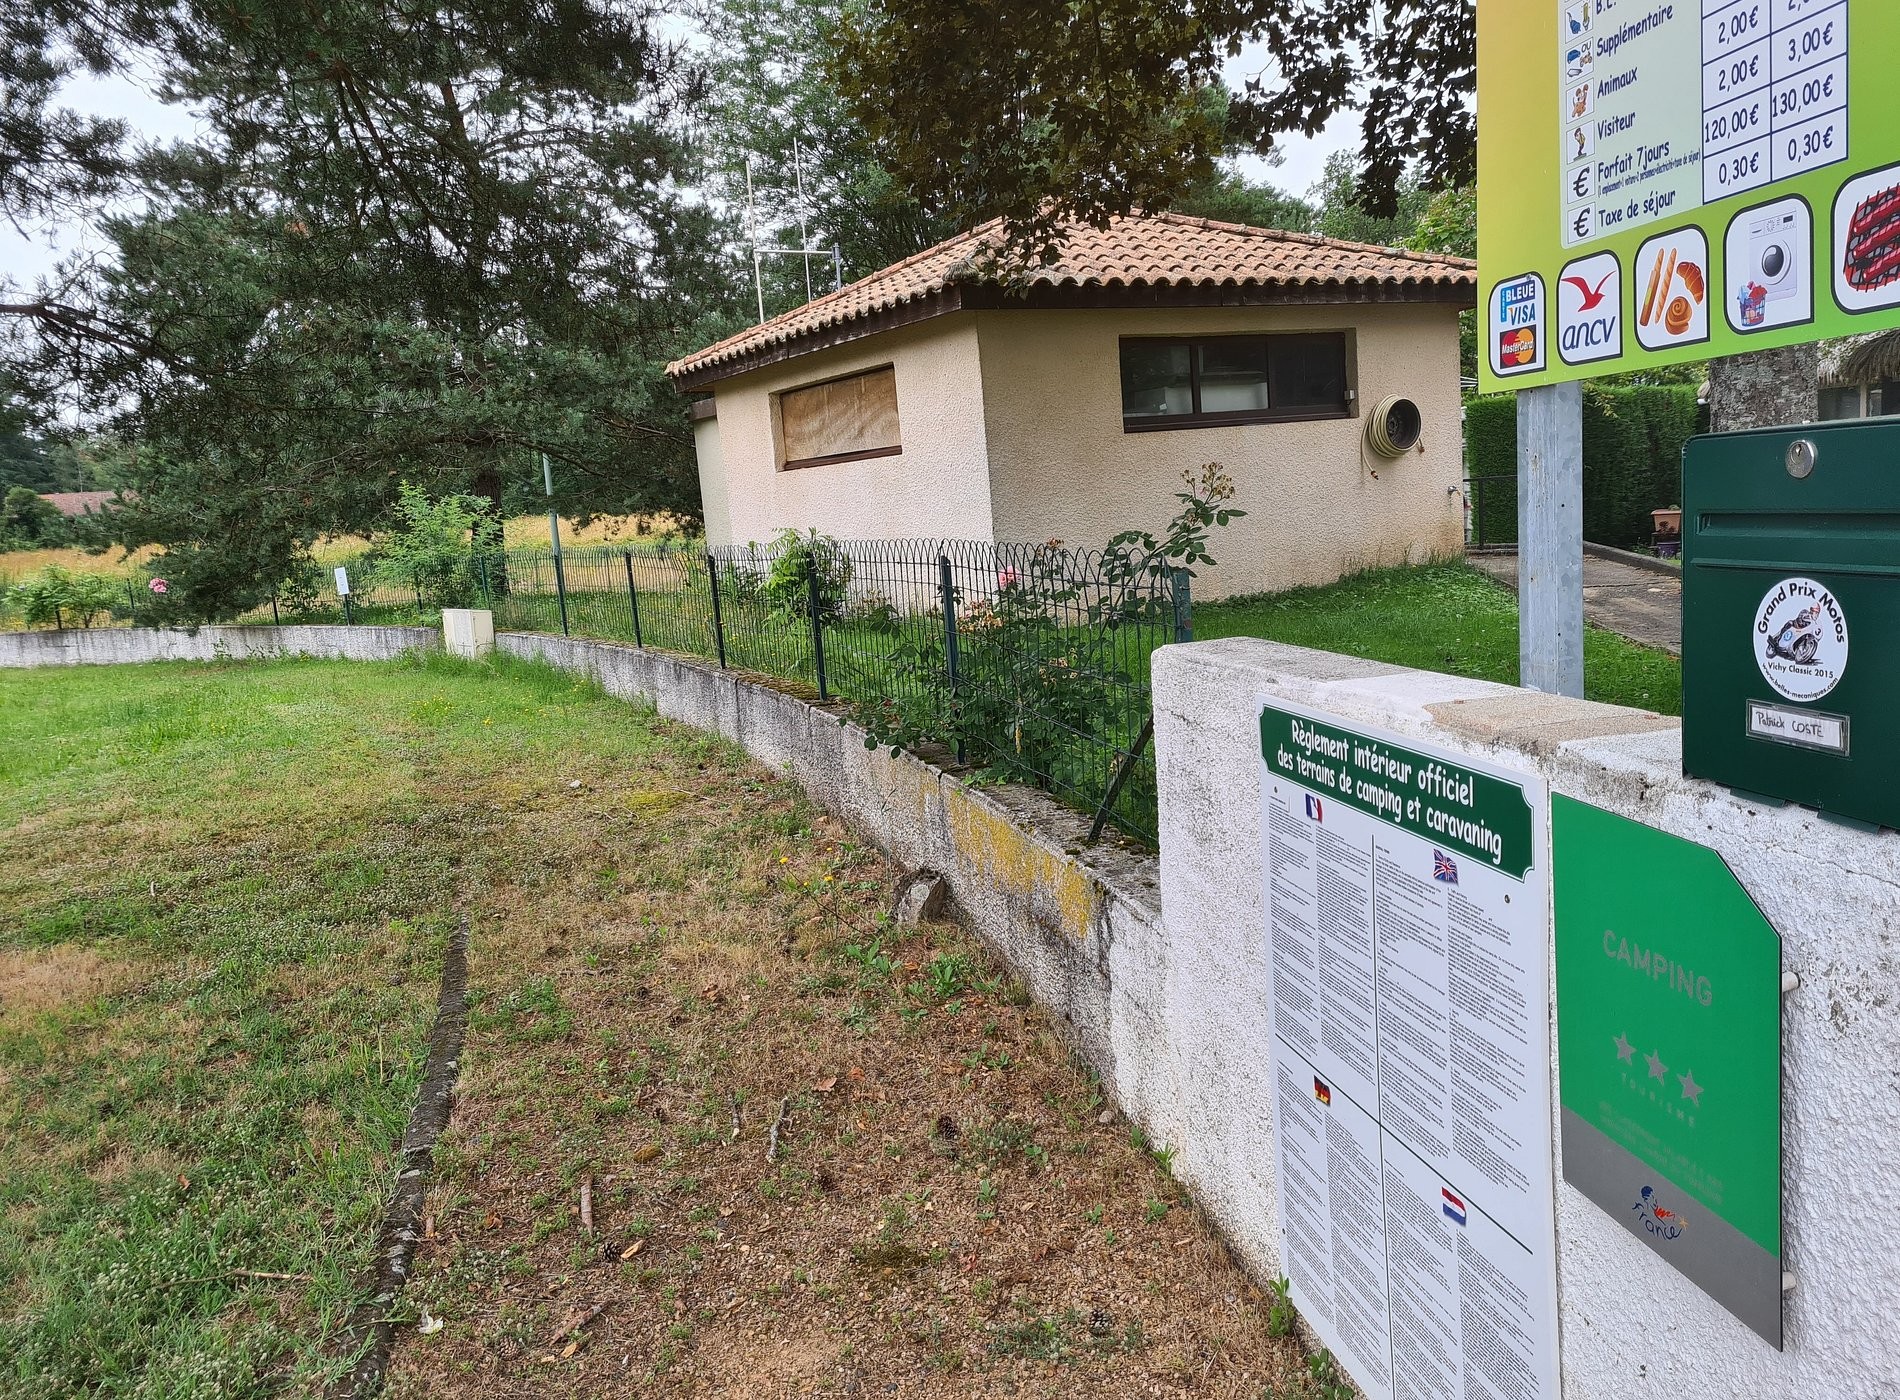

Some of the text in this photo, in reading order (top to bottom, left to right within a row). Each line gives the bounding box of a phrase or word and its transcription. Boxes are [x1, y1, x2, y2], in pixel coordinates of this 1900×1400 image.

[1581, 40, 1592, 52] OU
[1597, 5, 1673, 57] Supplémentaire
[1597, 67, 1638, 99] Animaux
[1597, 112, 1636, 140] Visiteur
[1598, 153, 1633, 182] Forfait
[1598, 190, 1676, 227] Taxe de séjour
[1506, 284, 1534, 302] BLEUE
[1508, 303, 1535, 325] VISA
[1502, 340, 1534, 354] MasterCard
[1758, 582, 1845, 643] Grand Prix Motos
[1762, 663, 1838, 699] www.belles-mecaniques.com
[1768, 662, 1834, 679] Vichy Classic 2015
[1756, 711, 1824, 737] Patrick COSTE
[1292, 719, 1473, 807] Règlement intérieur officiel
[1277, 744, 1502, 865] des terrains de camping et caravaning
[1603, 929, 1713, 1006] CAMPING
